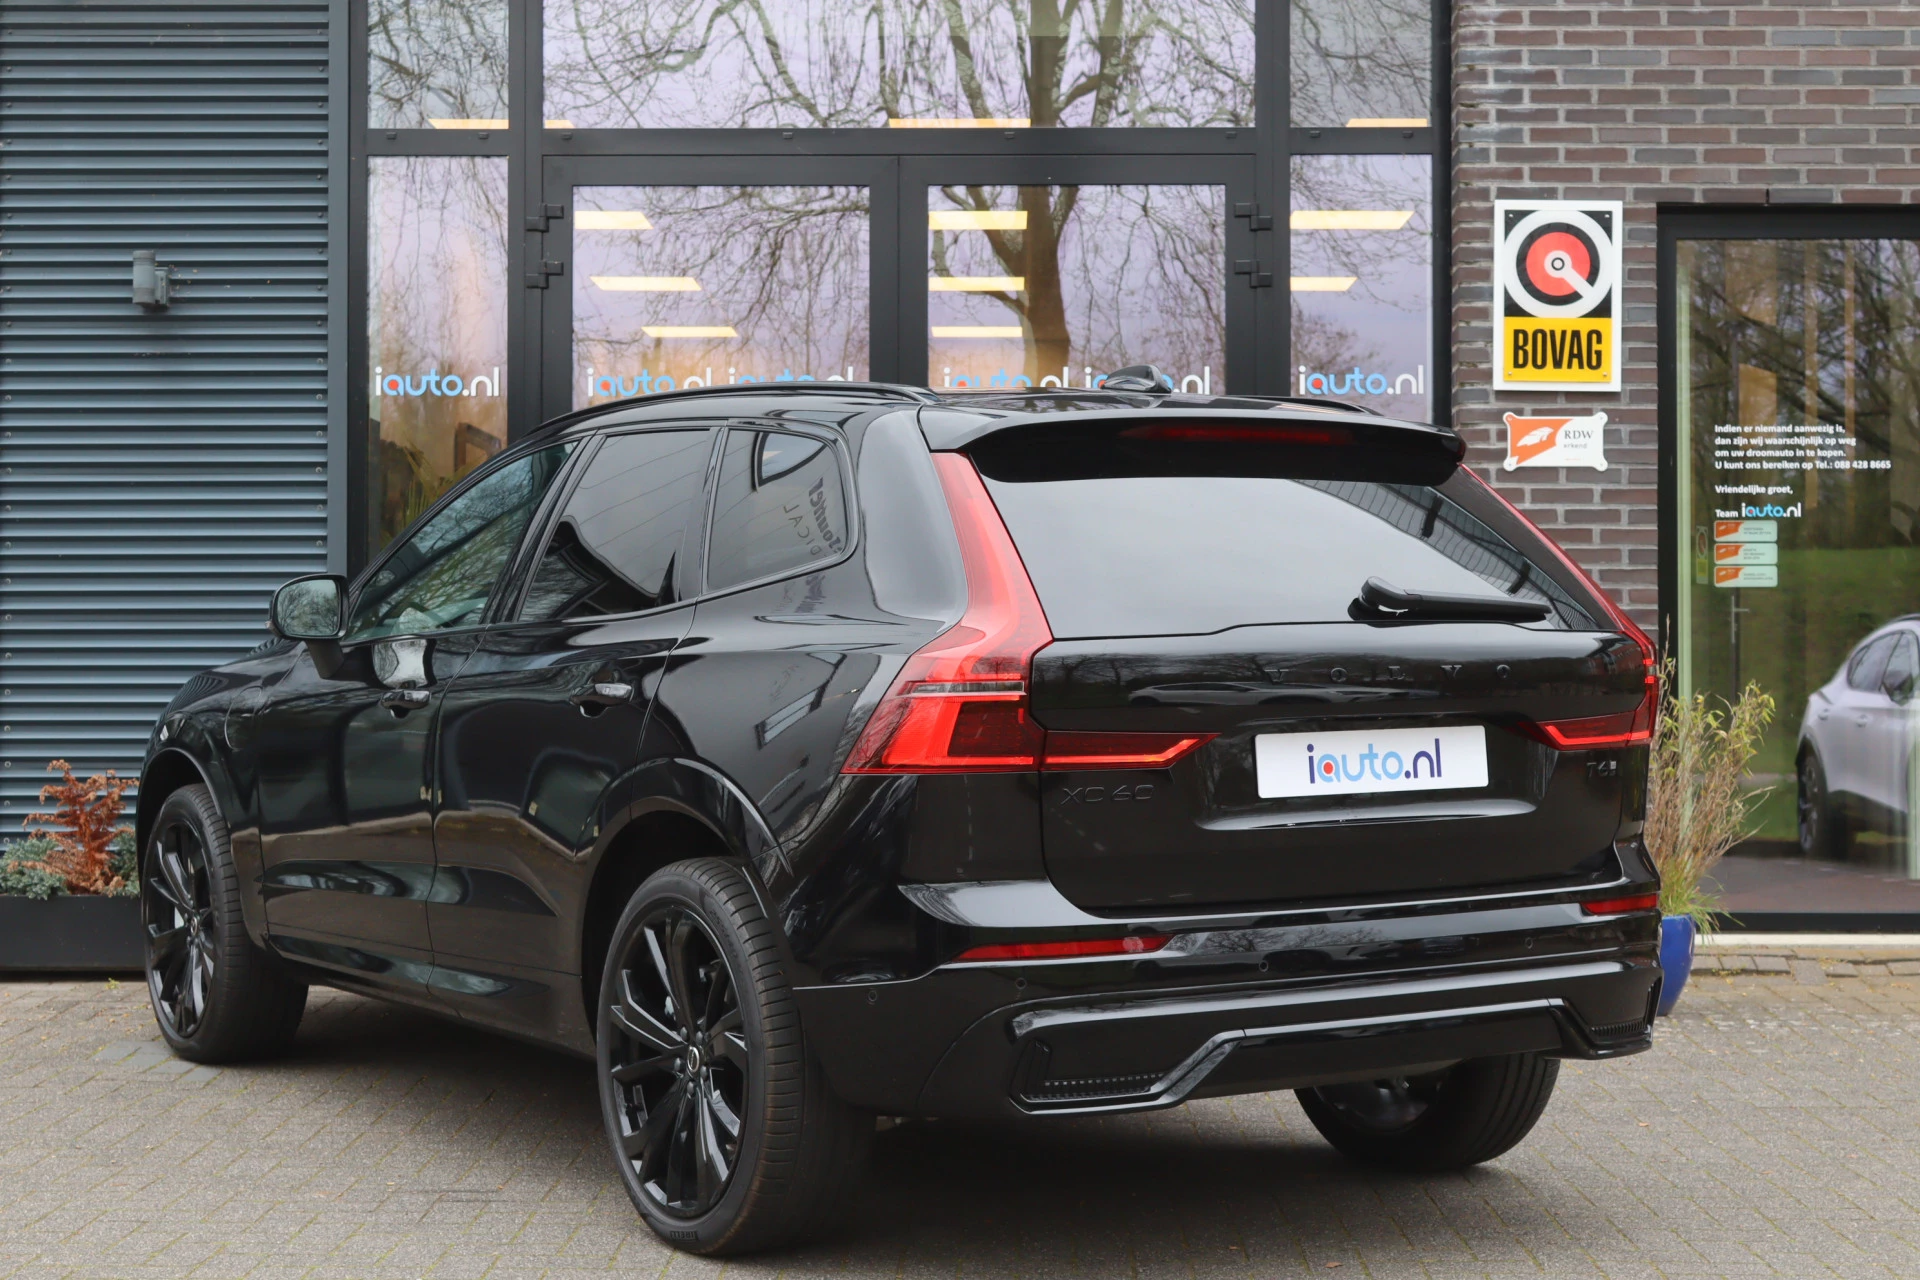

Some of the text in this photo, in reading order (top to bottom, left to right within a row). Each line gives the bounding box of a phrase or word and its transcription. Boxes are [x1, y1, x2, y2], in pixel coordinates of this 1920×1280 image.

[1513, 328, 1603, 370] BOVAG
[375, 366, 500, 397] iauto.nl
[587, 367, 712, 397] iautonl
[1298, 364, 1424, 395] iauto.nl
[1564, 430, 1593, 440] RDW
[1714, 424, 1742, 433] Indien
[1755, 424, 1793, 433] niemand
[1794, 424, 1834, 434] aanwezig
[1835, 424, 1846, 434] is,
[1714, 436, 1857, 446] dan zijn wij waarschijnlijk op weg
[1746, 449, 1795, 457] droomauto
[1796, 448, 1805, 457] in
[1806, 449, 1815, 457] te
[1817, 448, 1846, 458] kopen.
[1715, 461, 1722, 469] U
[1724, 461, 1744, 469] kunt
[1763, 461, 1800, 469] bereiken
[1815, 461, 1833, 469] Tel.:
[1834, 461, 1850, 469] 088
[1852, 461, 1868, 469] 428
[1870, 461, 1891, 469] 8665
[1715, 485, 1793, 495] Vriendelijke groet,
[1715, 502, 1802, 518] Team iauto.nl
[1264, 664, 1511, 683] VOLVO
[1306, 738, 1442, 784] iauto.nl
